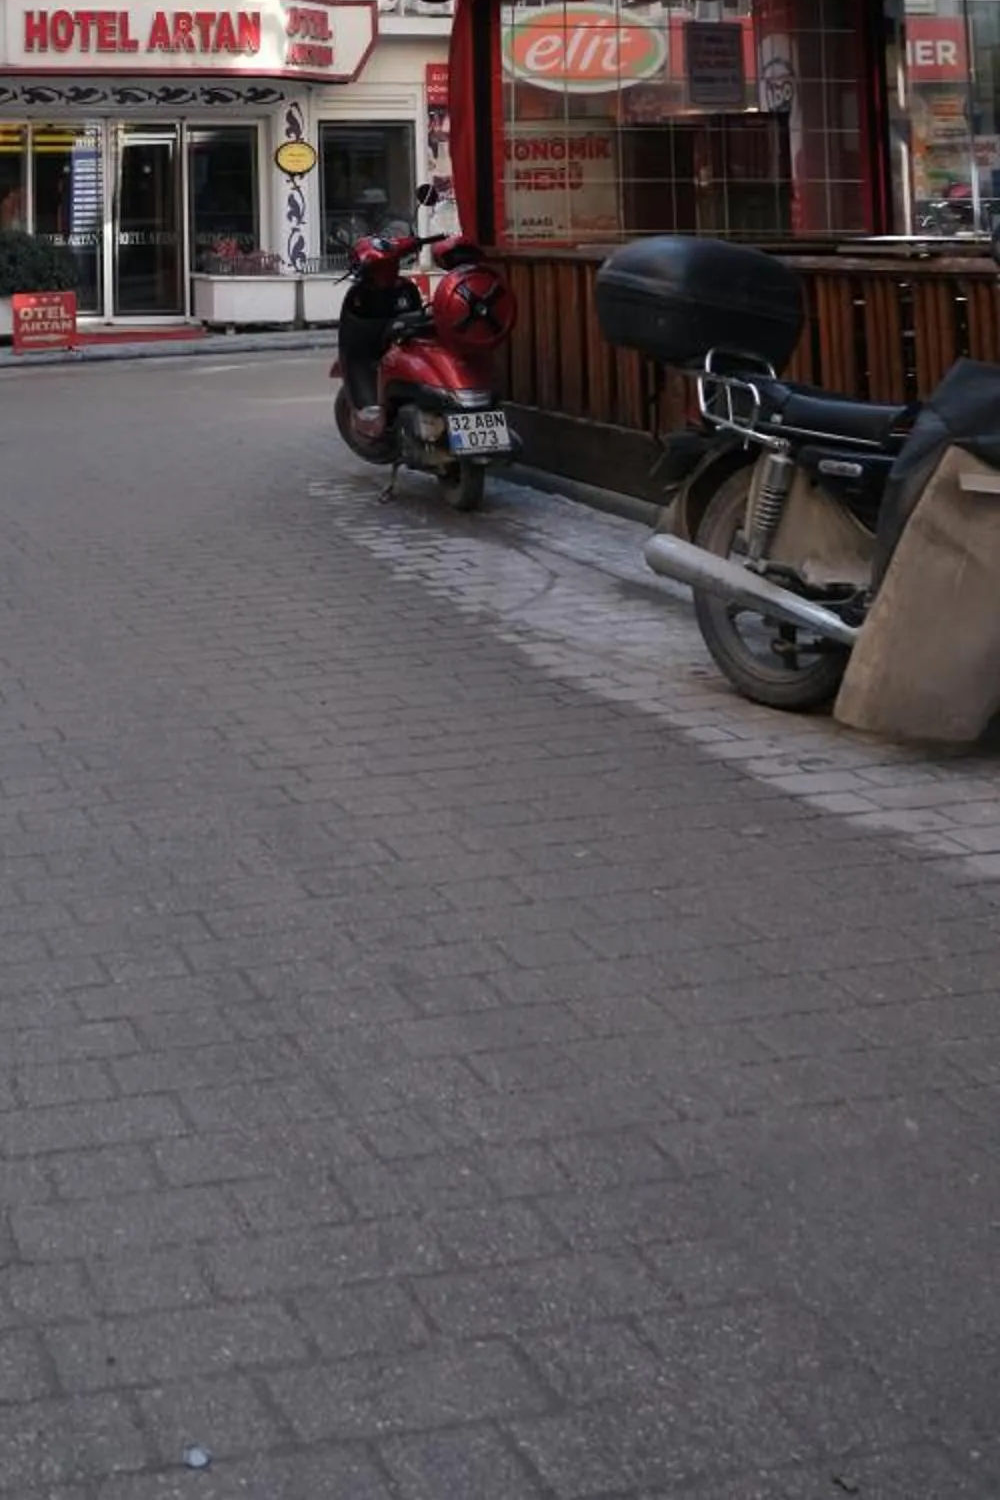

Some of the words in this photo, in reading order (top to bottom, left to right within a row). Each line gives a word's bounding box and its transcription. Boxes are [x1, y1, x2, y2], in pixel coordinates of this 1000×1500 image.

[23, 9, 139, 54] HOTEL
[146, 10, 261, 55] ARTAN
[524, 19, 633, 72] elit
[19, 305, 71, 321] OTEL
[19, 320, 73, 334] ARTAN
[451, 415, 471, 430] 32
[475, 413, 505, 429] ABN
[468, 430, 499, 447] 073
